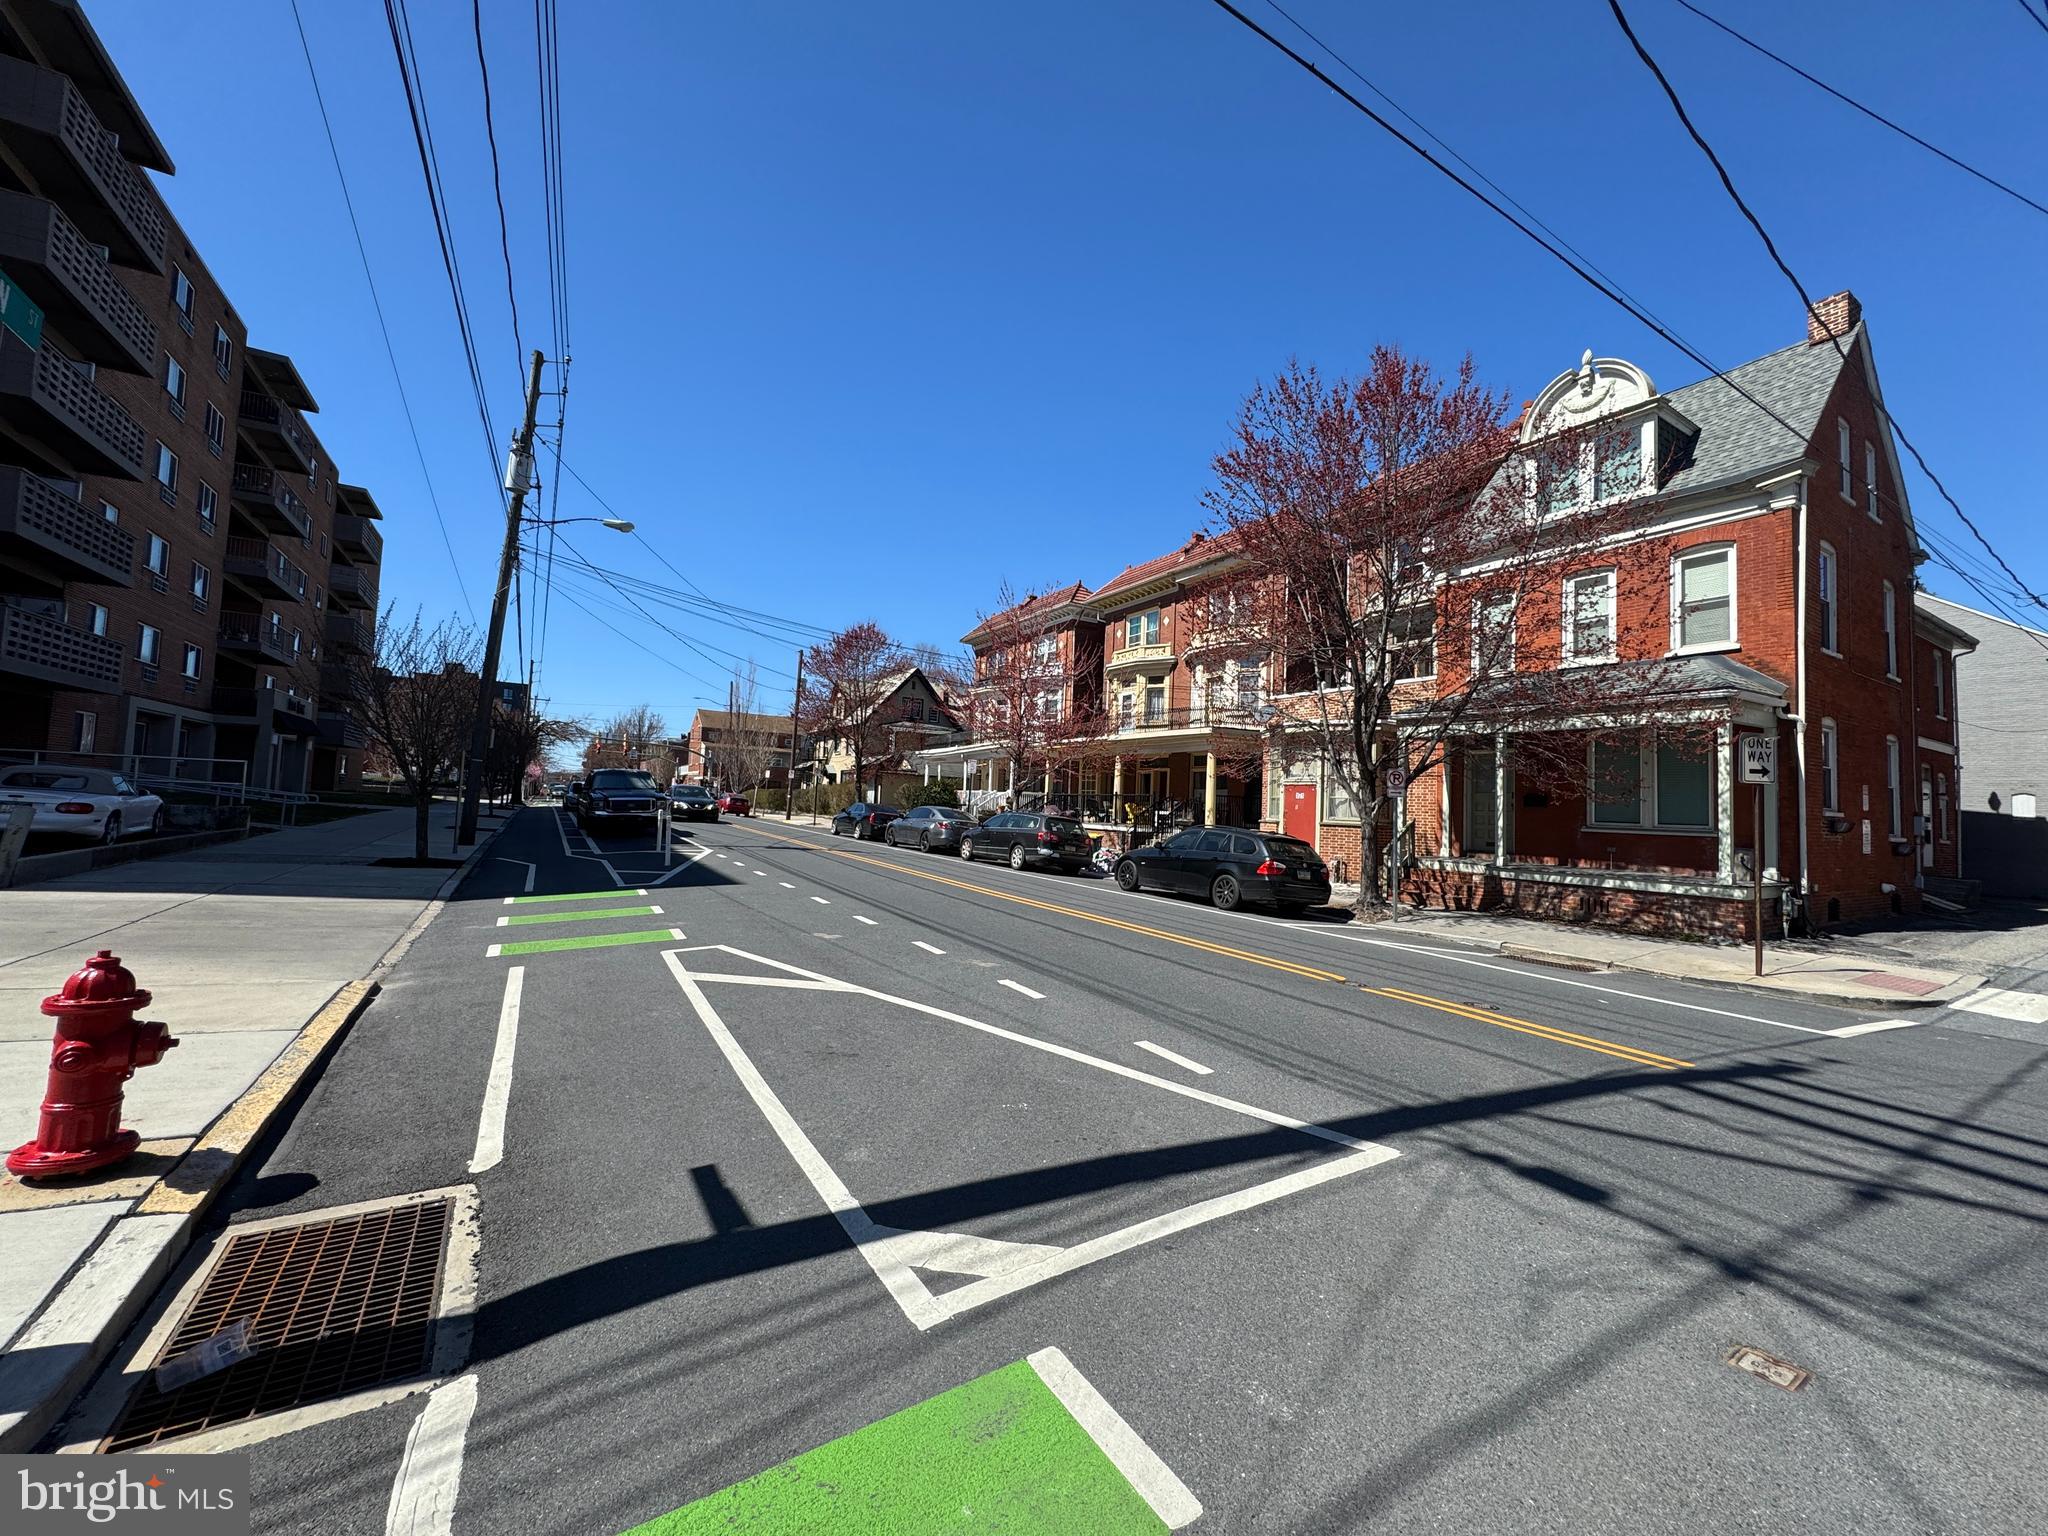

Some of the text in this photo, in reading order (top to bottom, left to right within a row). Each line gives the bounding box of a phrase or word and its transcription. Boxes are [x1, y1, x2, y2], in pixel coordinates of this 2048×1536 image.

[28, 309, 39, 328] ST
[1748, 738, 1772, 749] ONE
[1748, 751, 1772, 763] WAY
